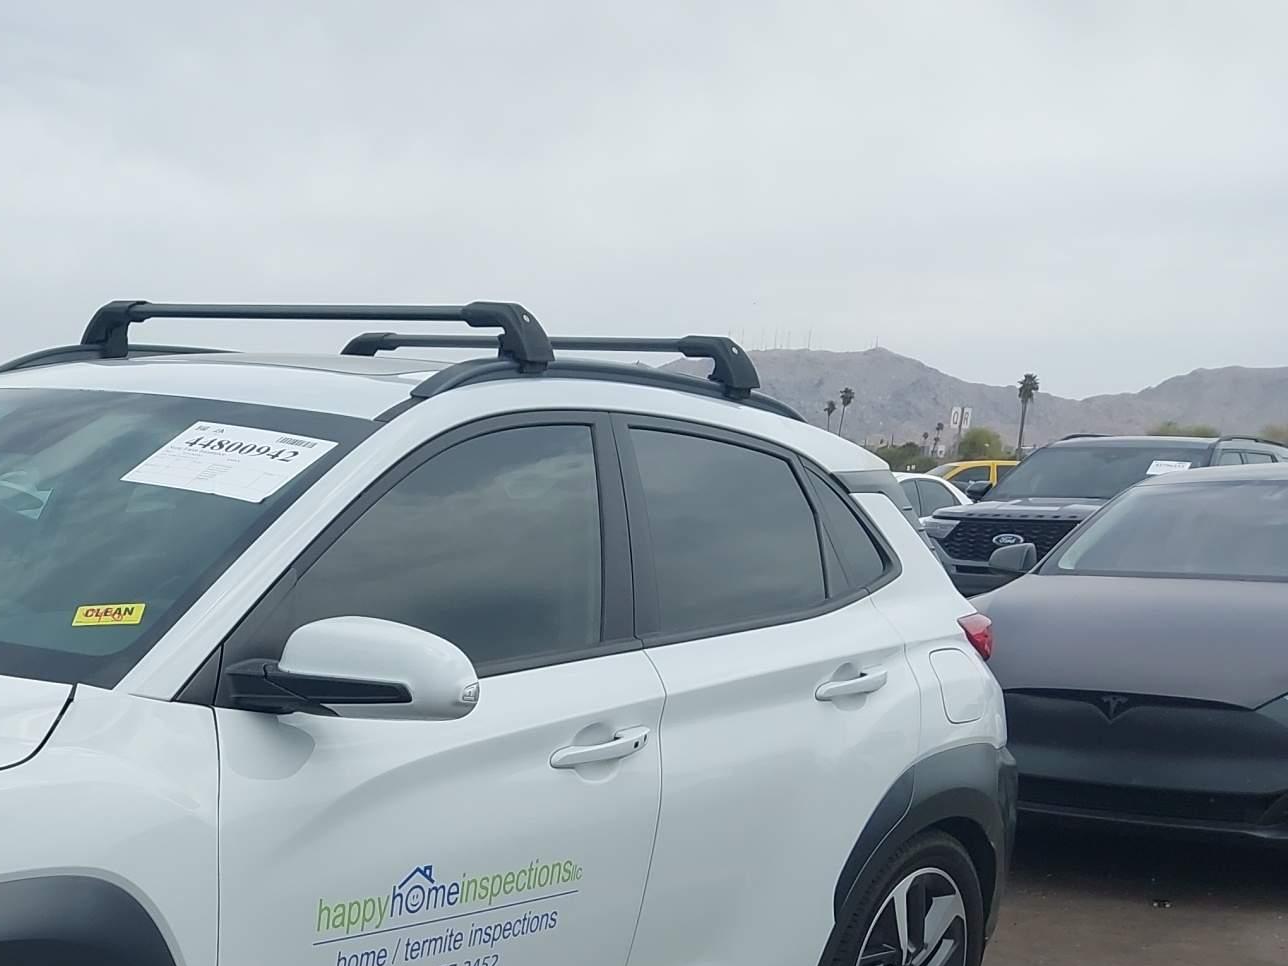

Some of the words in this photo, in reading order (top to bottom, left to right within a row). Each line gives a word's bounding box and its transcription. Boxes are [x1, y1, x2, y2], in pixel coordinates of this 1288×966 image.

[185, 435, 299, 463] 44800942
[84, 606, 135, 618] CLEAN
[404, 930, 463, 962] termite
[468, 910, 558, 948] inspections
